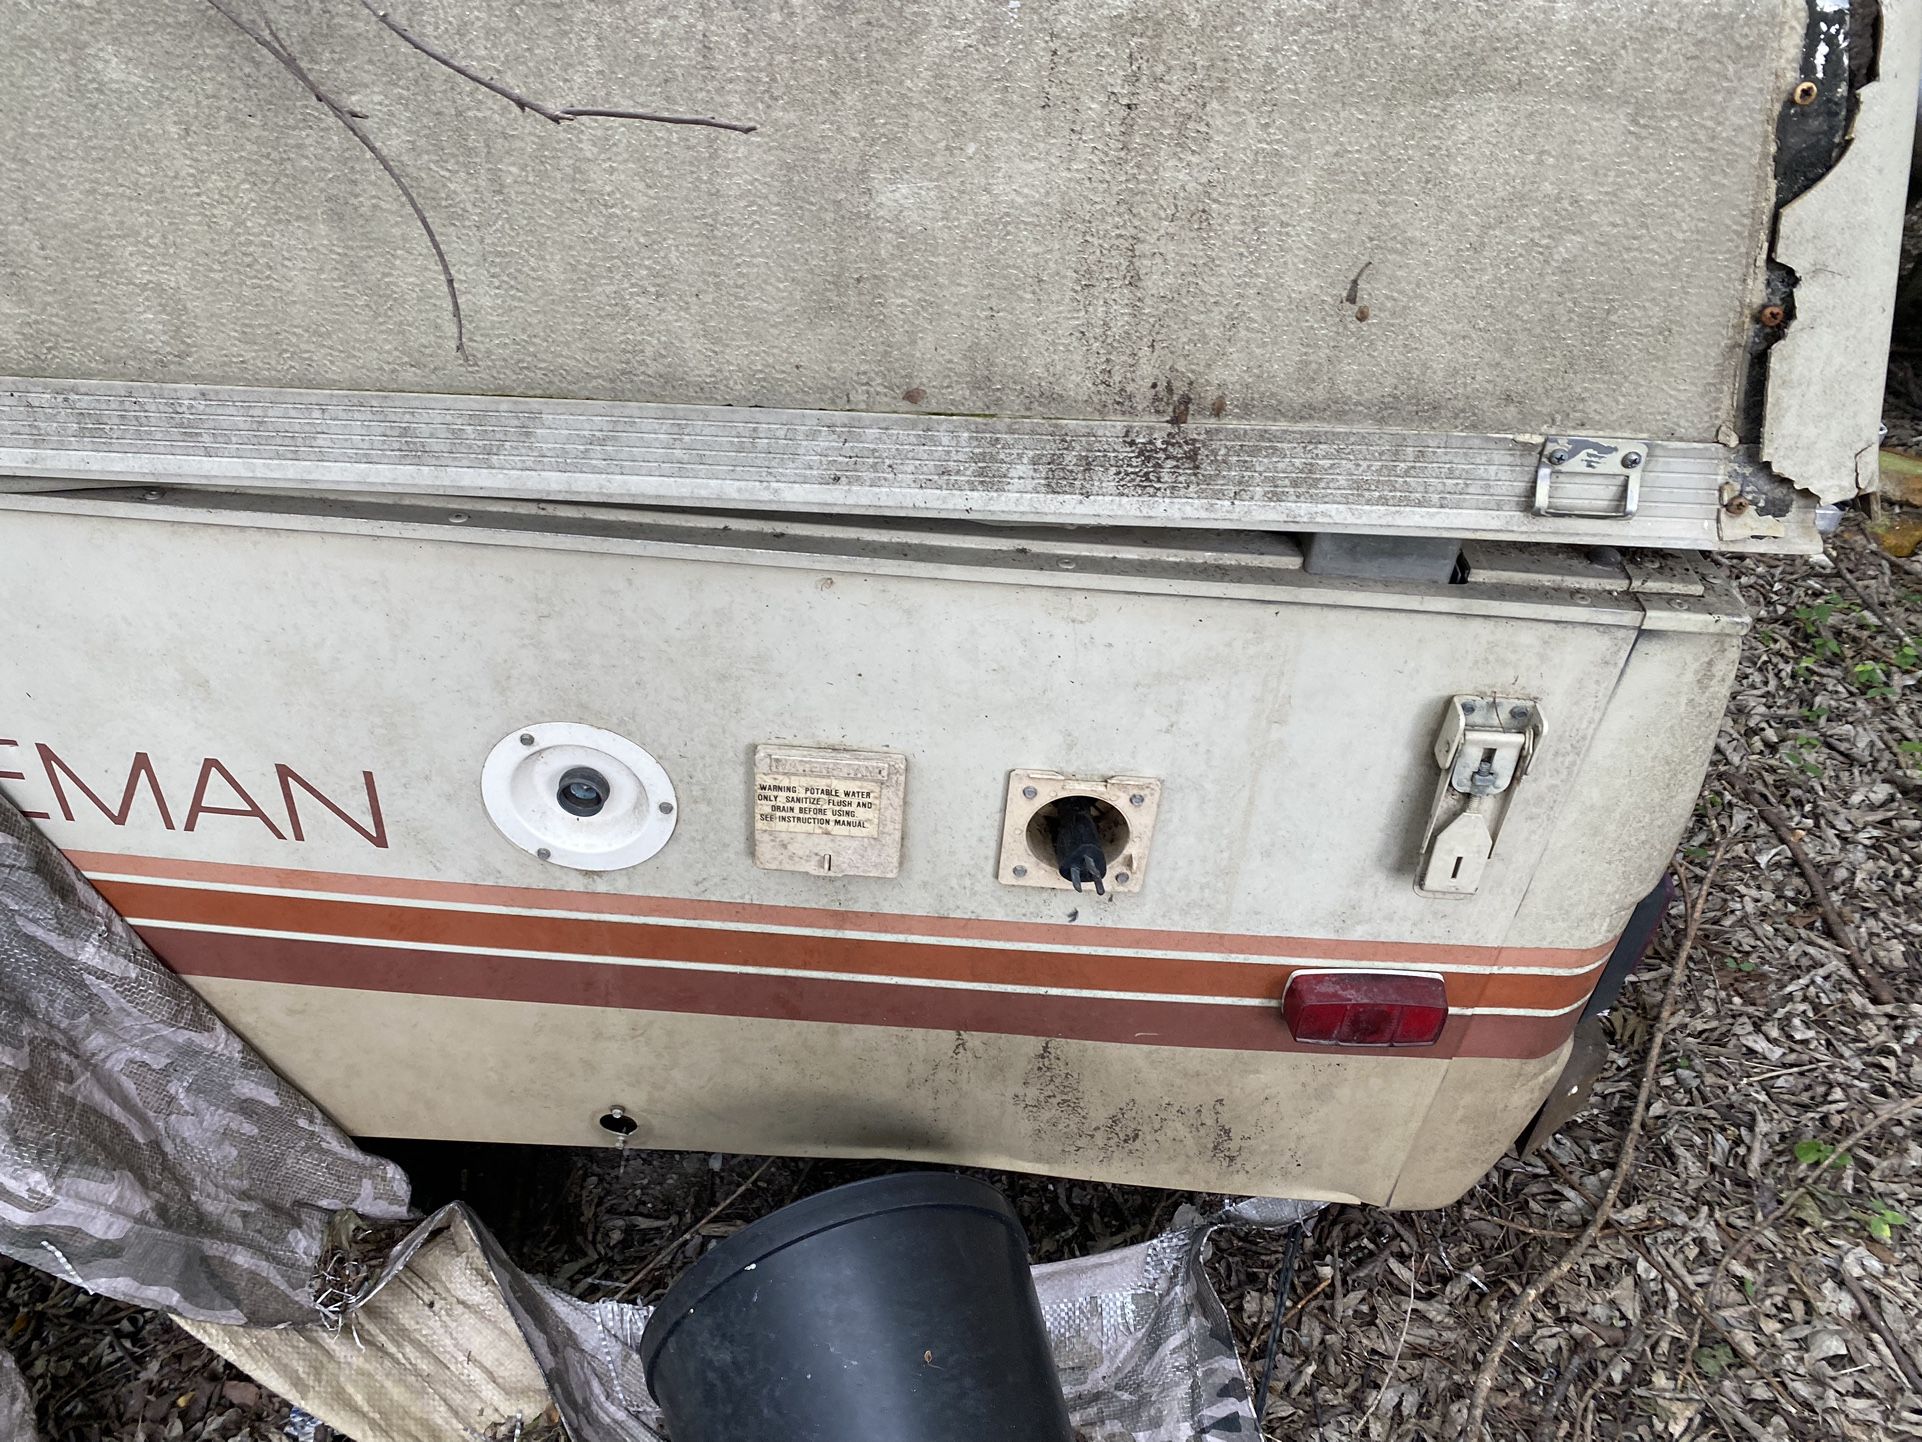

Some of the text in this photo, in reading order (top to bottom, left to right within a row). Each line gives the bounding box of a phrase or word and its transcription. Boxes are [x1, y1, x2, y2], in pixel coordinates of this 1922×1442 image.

[804, 787, 839, 797] POTABLE
[843, 790, 871, 799] WATER
[827, 799, 853, 808] FLUSH
[856, 801, 873, 809] AND
[770, 804, 859, 818] DRAIN BEFORE USING.
[778, 815, 830, 826] INSTRUCTION
